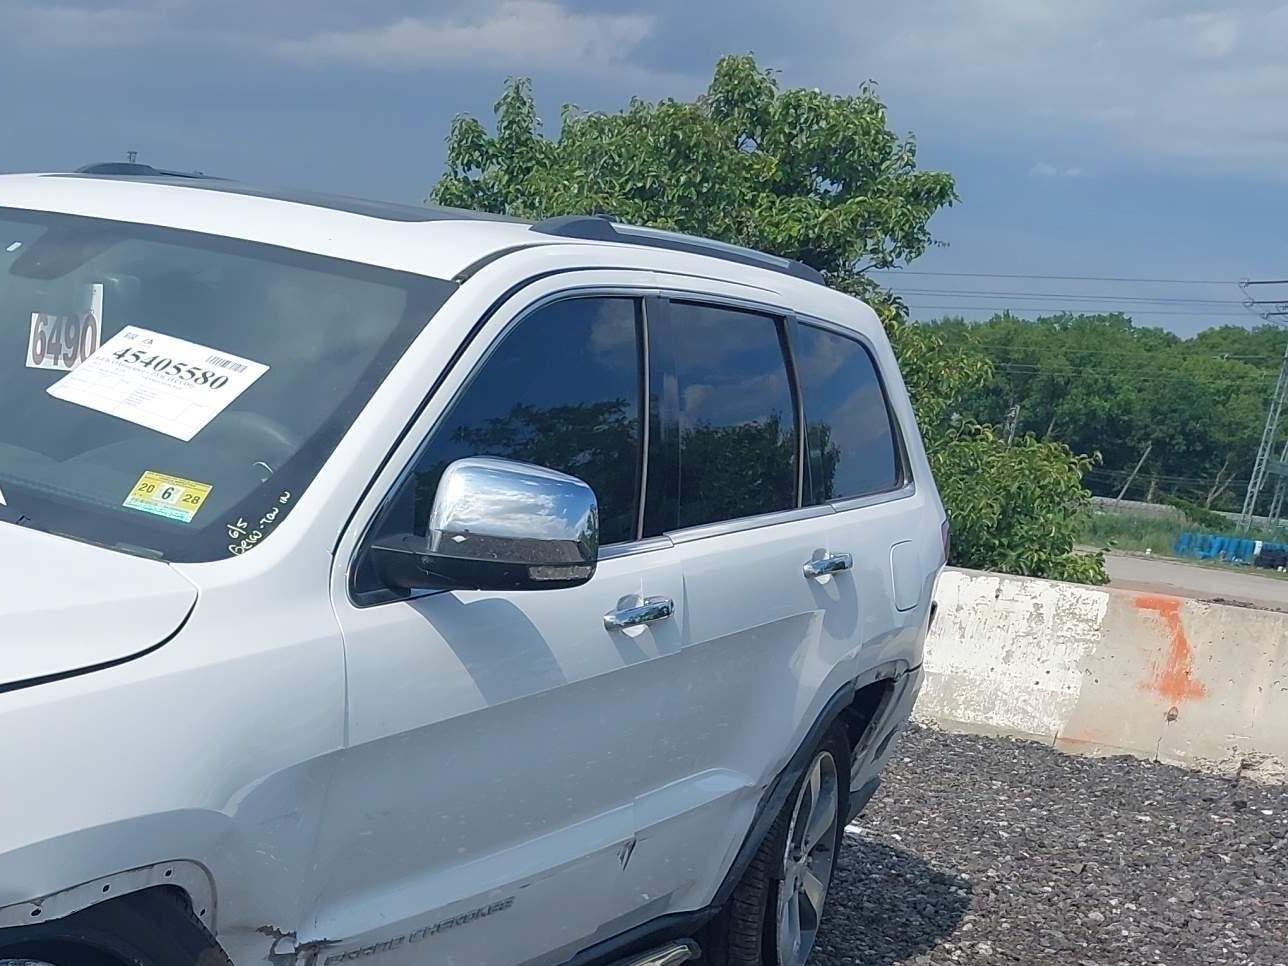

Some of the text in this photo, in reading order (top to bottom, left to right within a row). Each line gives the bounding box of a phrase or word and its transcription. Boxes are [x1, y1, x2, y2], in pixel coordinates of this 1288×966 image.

[32, 312, 97, 368] 6490
[113, 347, 229, 390] 45405580
[138, 483, 155, 493] 20
[161, 487, 174, 500] 6
[182, 494, 200, 505] 28
